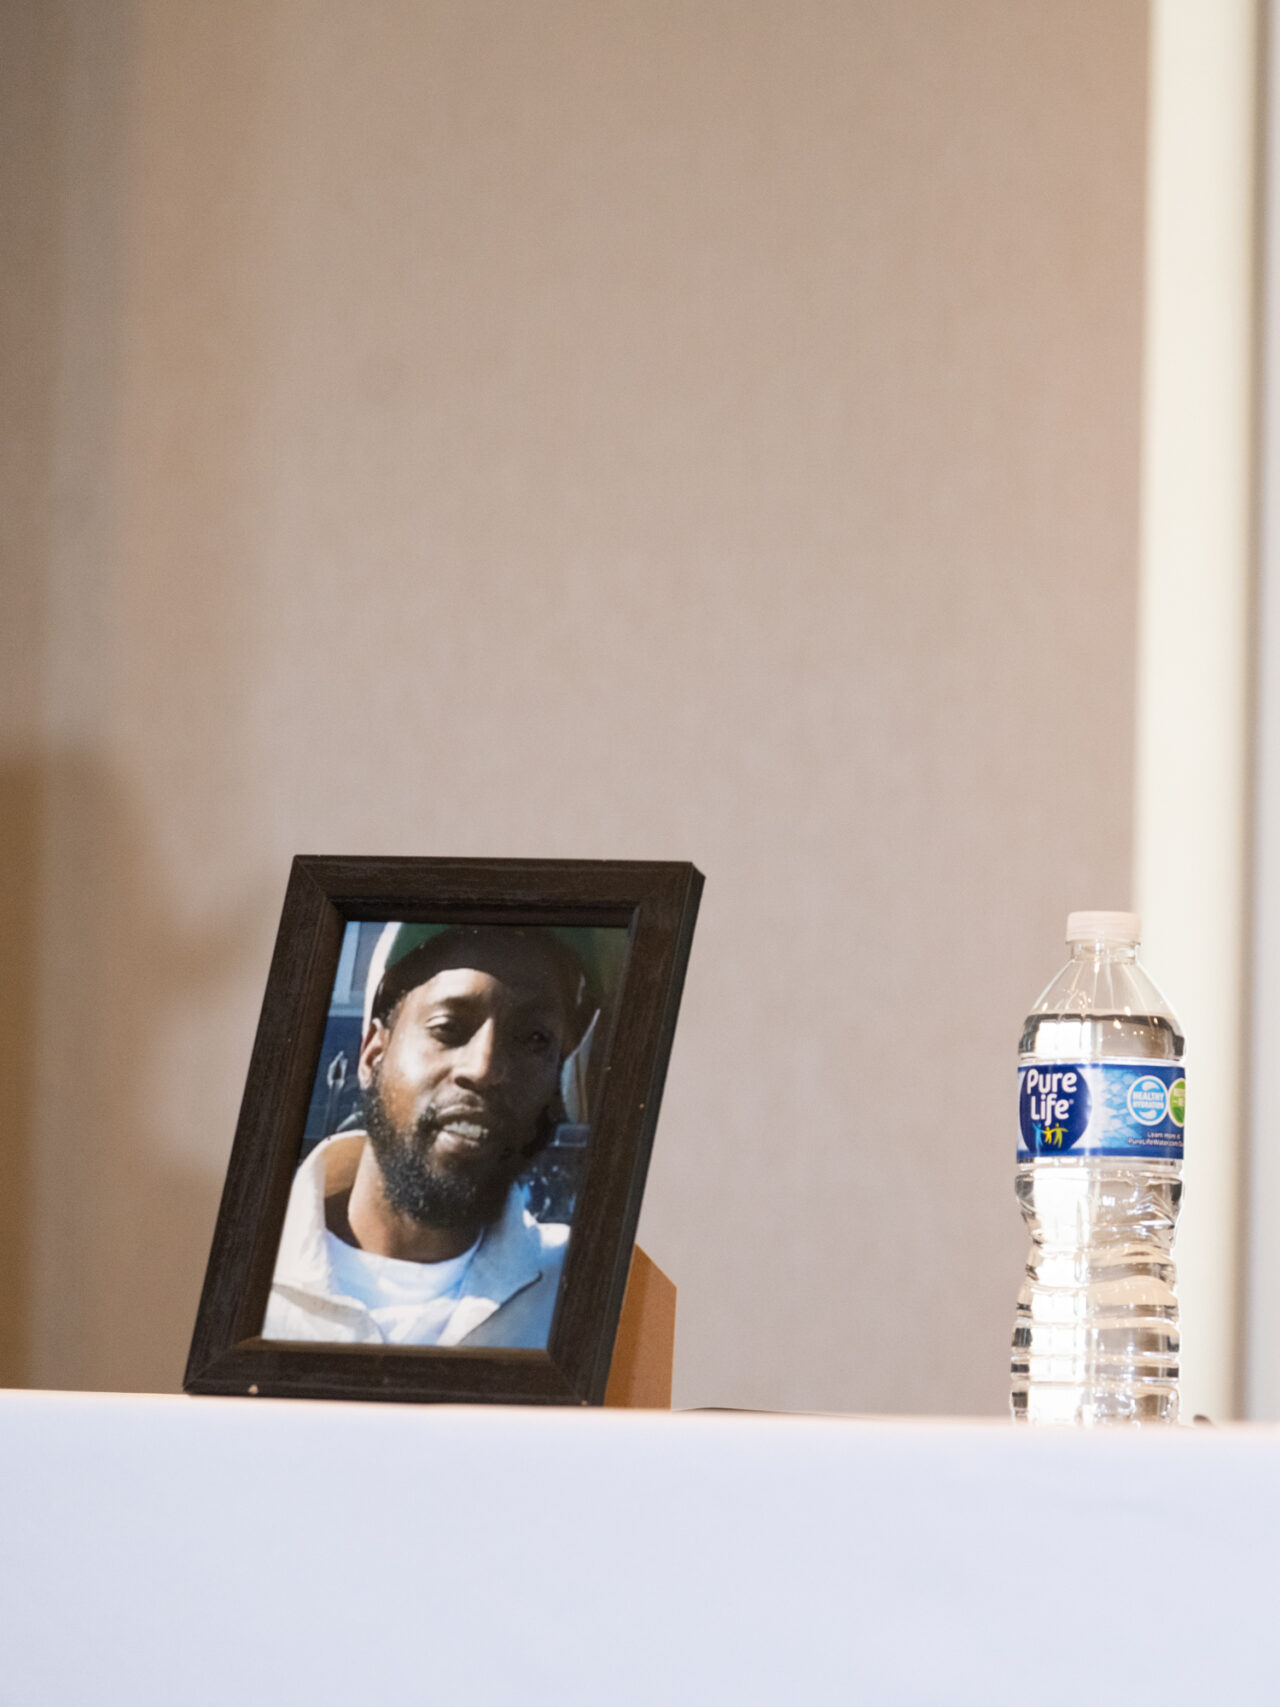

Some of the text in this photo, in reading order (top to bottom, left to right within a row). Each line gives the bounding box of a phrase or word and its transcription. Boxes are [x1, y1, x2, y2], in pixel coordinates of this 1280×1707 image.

[1026, 1069, 1077, 1094] Pure
[1133, 1091, 1164, 1100] HEALTHY
[1030, 1094, 1069, 1126] Life
